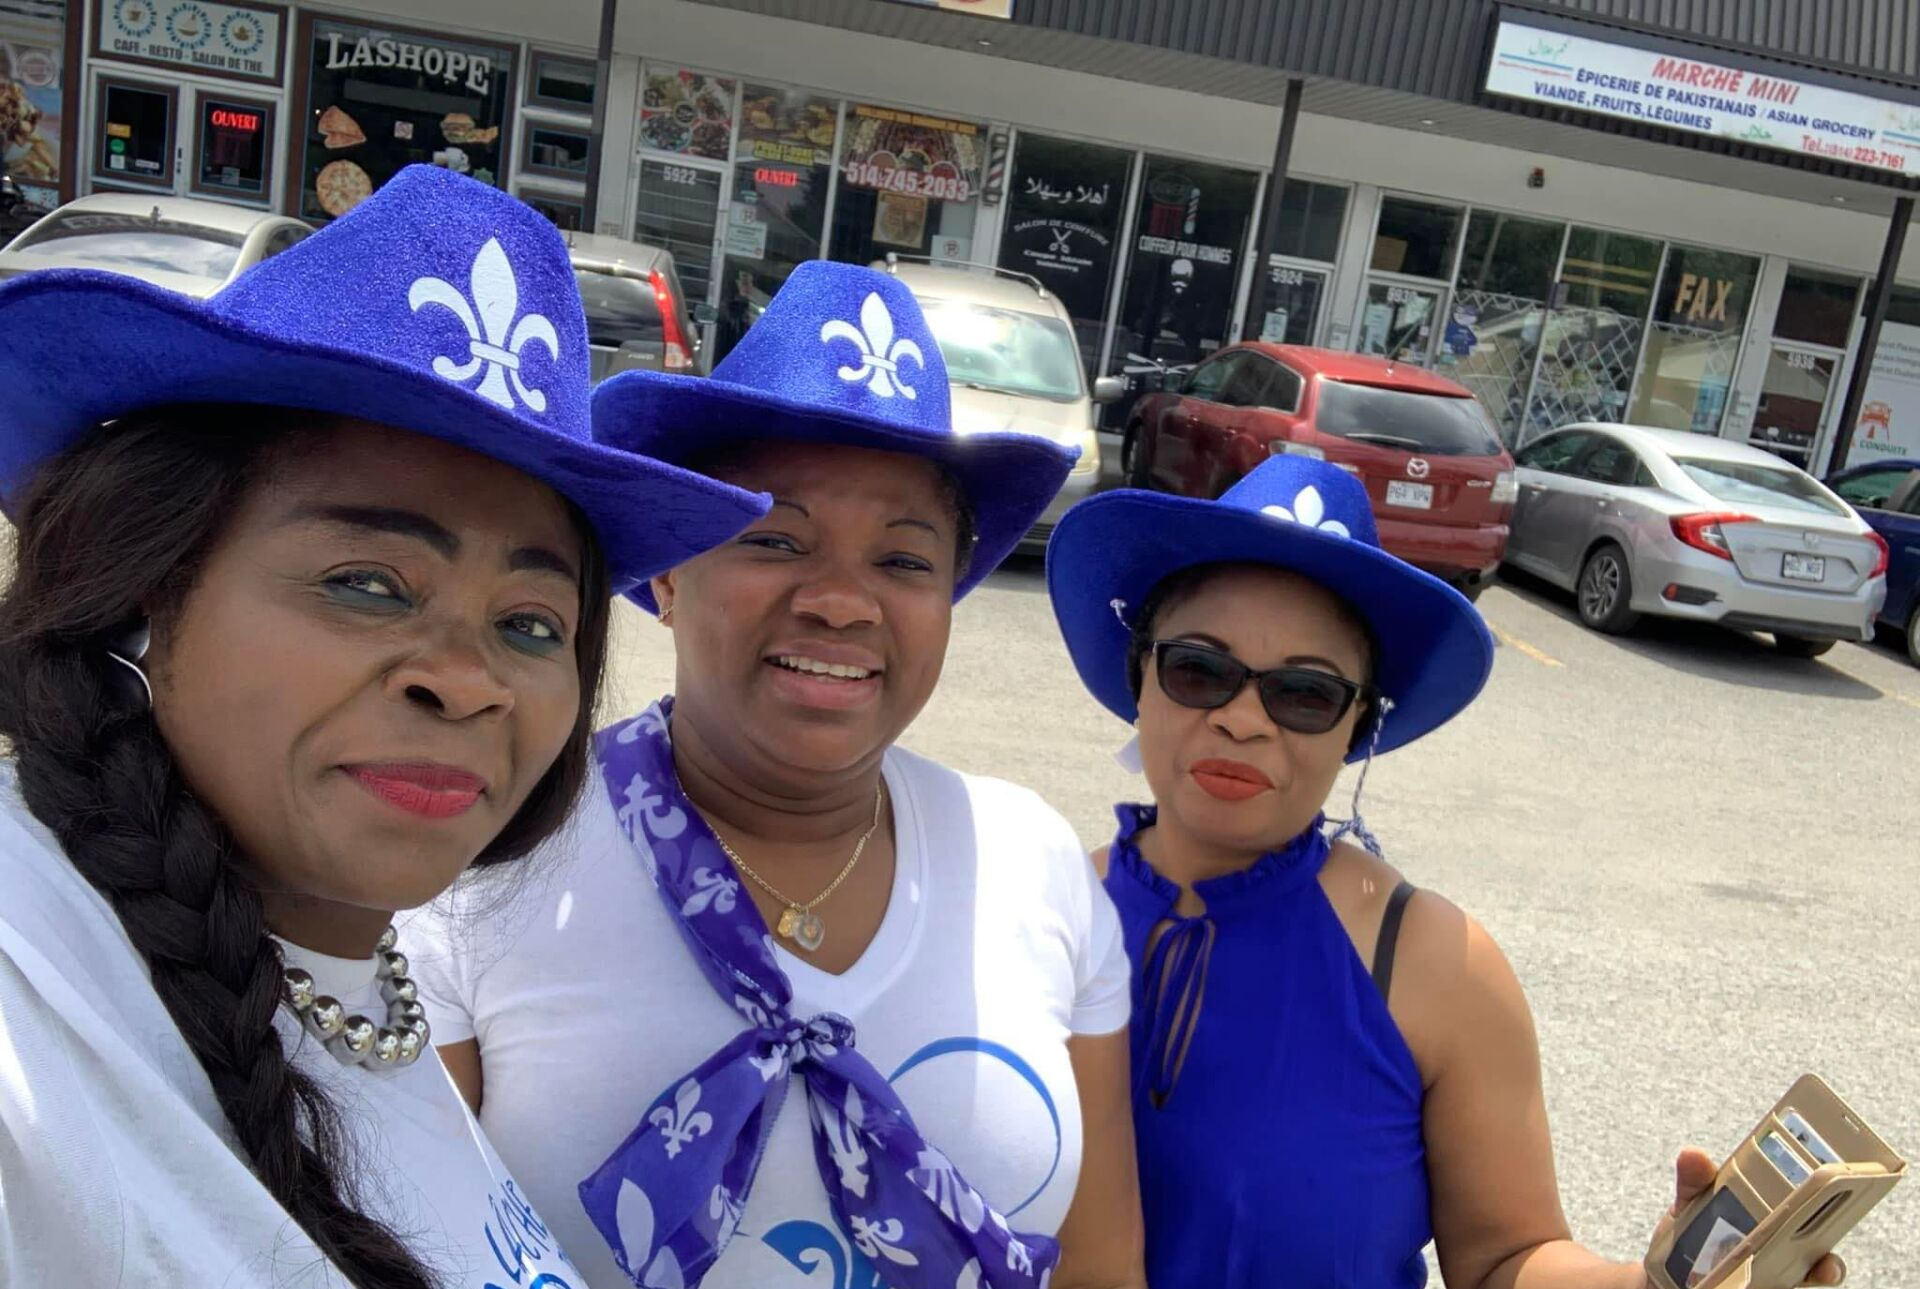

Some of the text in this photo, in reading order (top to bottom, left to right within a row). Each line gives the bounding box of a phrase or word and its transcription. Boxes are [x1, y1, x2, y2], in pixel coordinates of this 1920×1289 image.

[149, 44, 183, 61] RESTO
[192, 51, 226, 66] SALON
[228, 57, 241, 70] DE
[244, 60, 263, 73] THE
[325, 32, 491, 96] LASHOPE
[1652, 57, 1801, 105] MARCHÉ MINI
[1576, 68, 1639, 93] ÉPICERIE
[1644, 83, 1662, 99] DE
[1666, 88, 1757, 118] PAKISTANAIS
[1767, 108, 1808, 126] ASIAN
[1812, 118, 1876, 140] GROCERY
[212, 110, 259, 131] OUVERT
[663, 165, 697, 186] 5922
[1176, 240, 1198, 259] POUR
[1272, 267, 1303, 286] 5924
[1674, 272, 1733, 321] FAX
